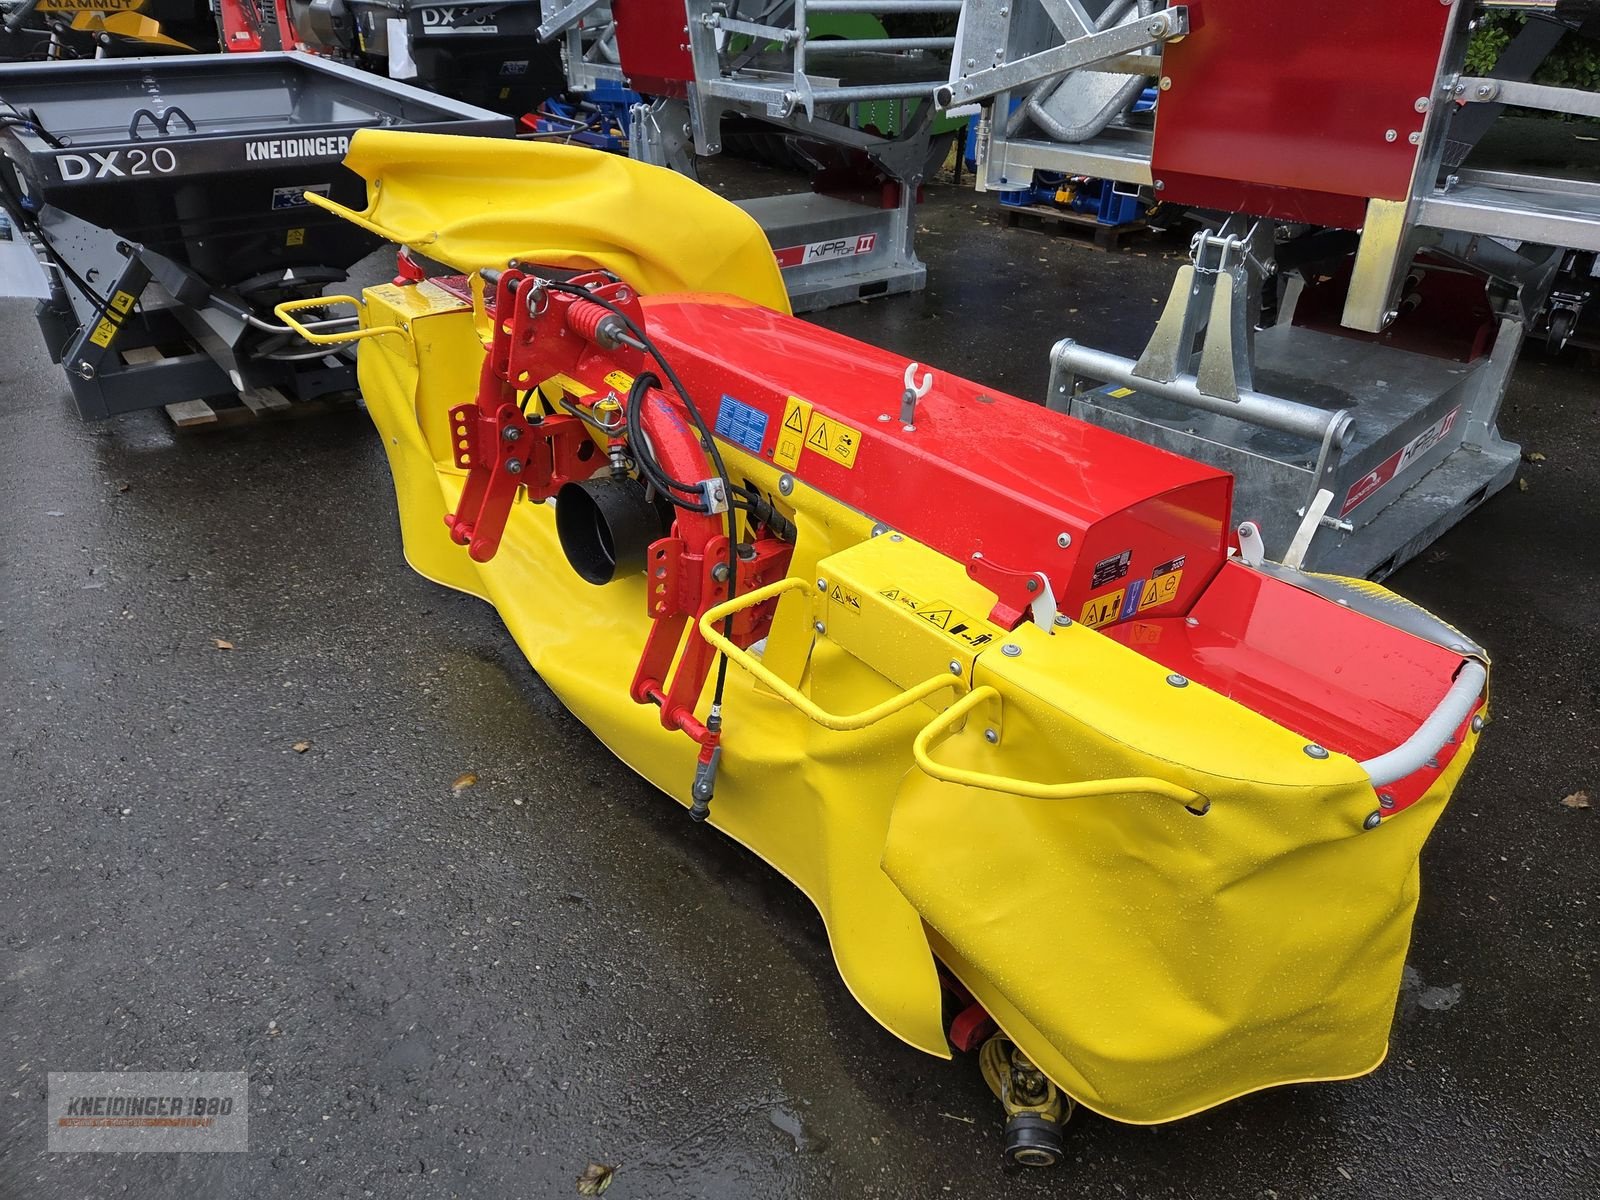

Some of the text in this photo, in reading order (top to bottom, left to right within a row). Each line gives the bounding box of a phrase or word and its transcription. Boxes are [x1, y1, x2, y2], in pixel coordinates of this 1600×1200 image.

[245, 136, 349, 161] KNEIDINGER
[56, 147, 176, 181] DX20
[809, 240, 846, 258] KIPP
